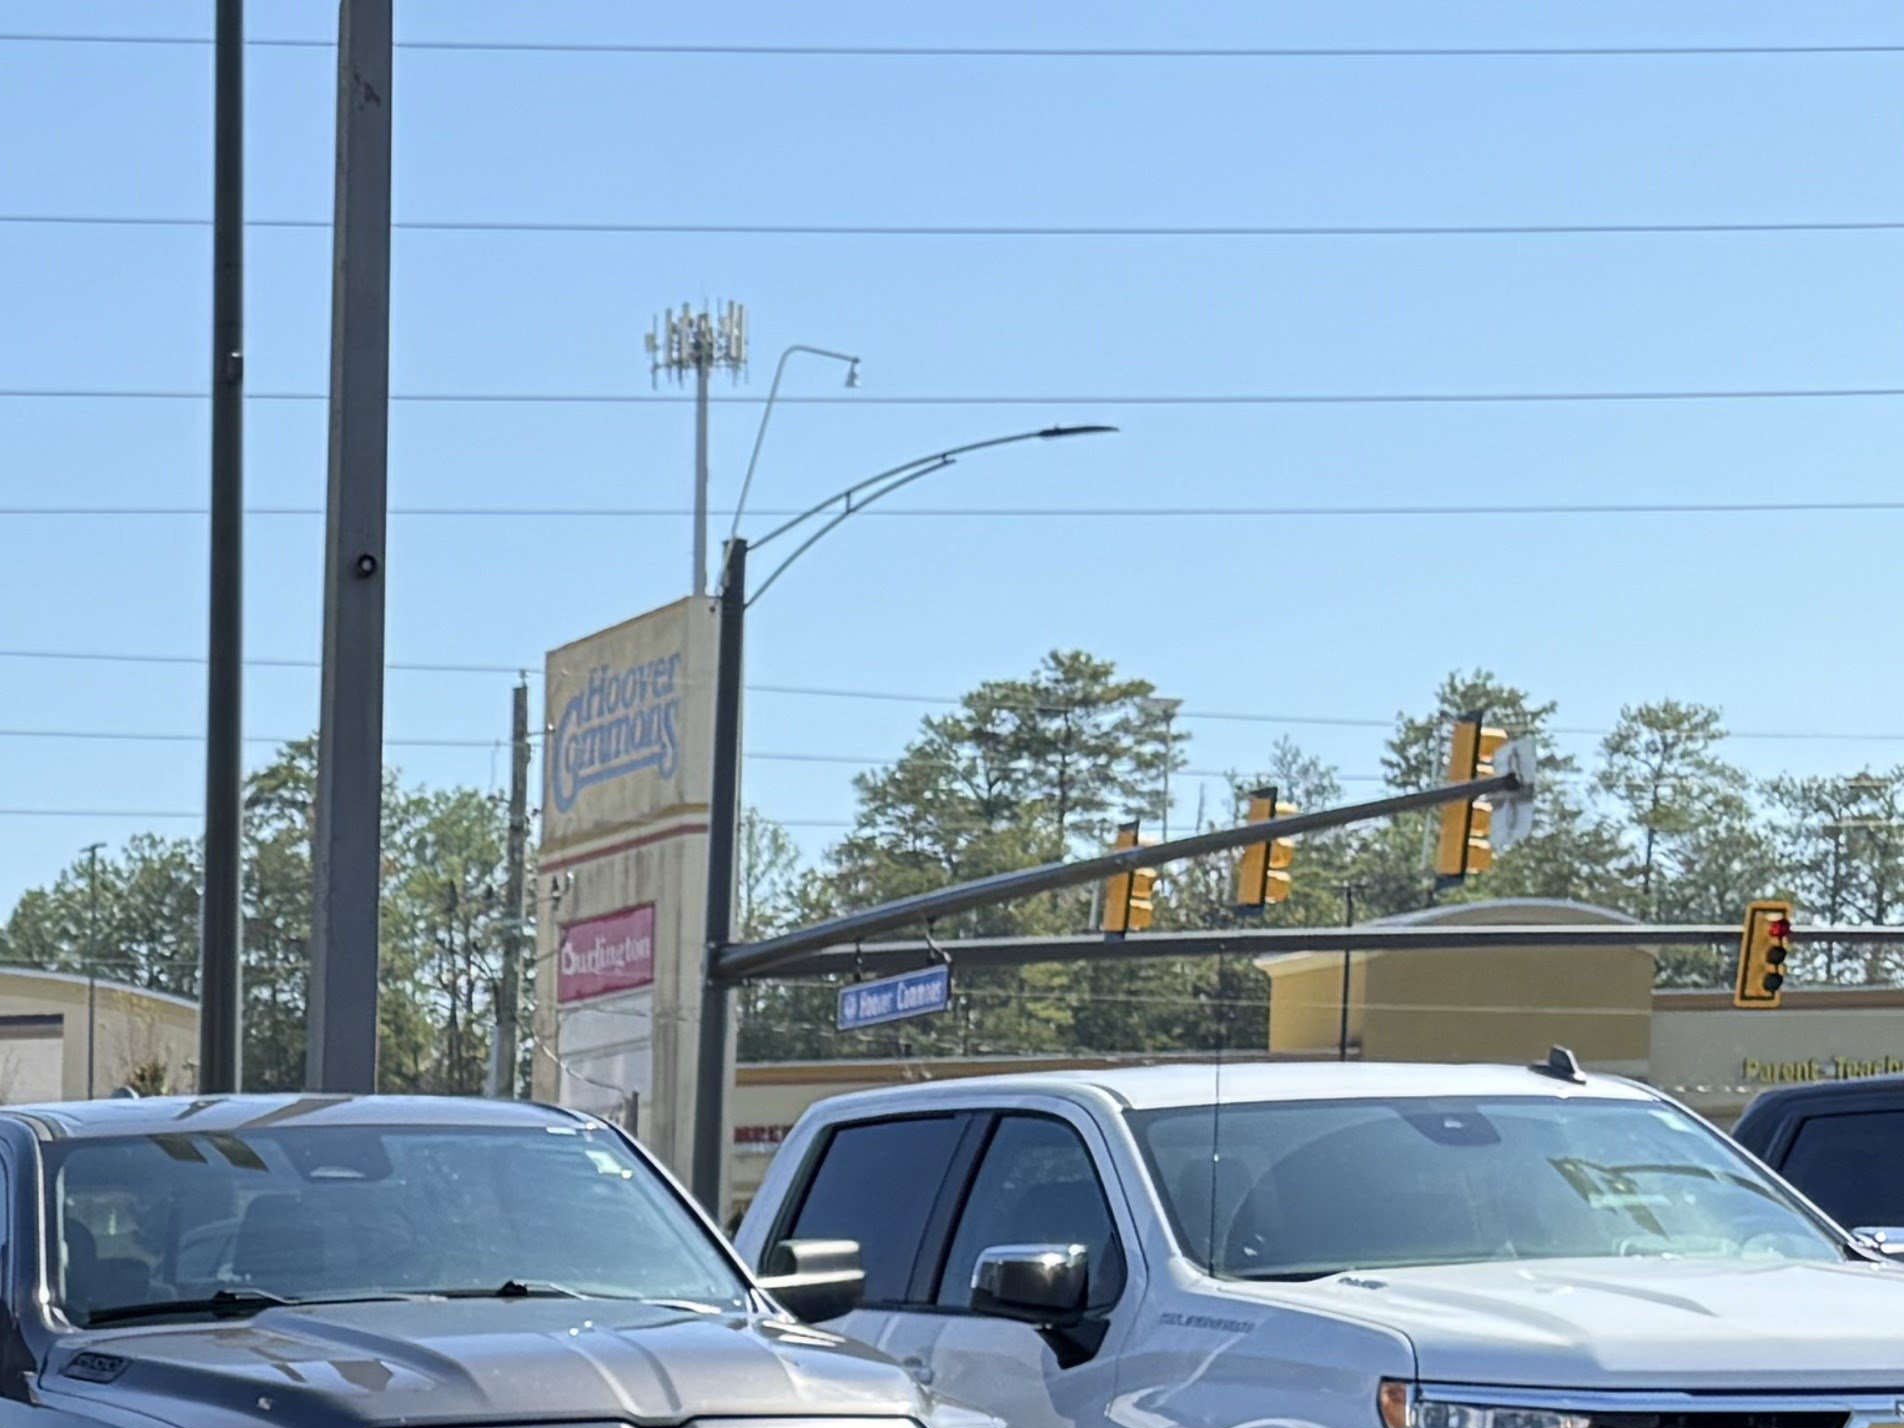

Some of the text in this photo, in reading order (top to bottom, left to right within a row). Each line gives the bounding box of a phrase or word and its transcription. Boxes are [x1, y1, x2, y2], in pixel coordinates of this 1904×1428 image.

[578, 652, 681, 728] Hoover
[553, 694, 680, 813] Commons
[561, 936, 652, 975] Burlington
